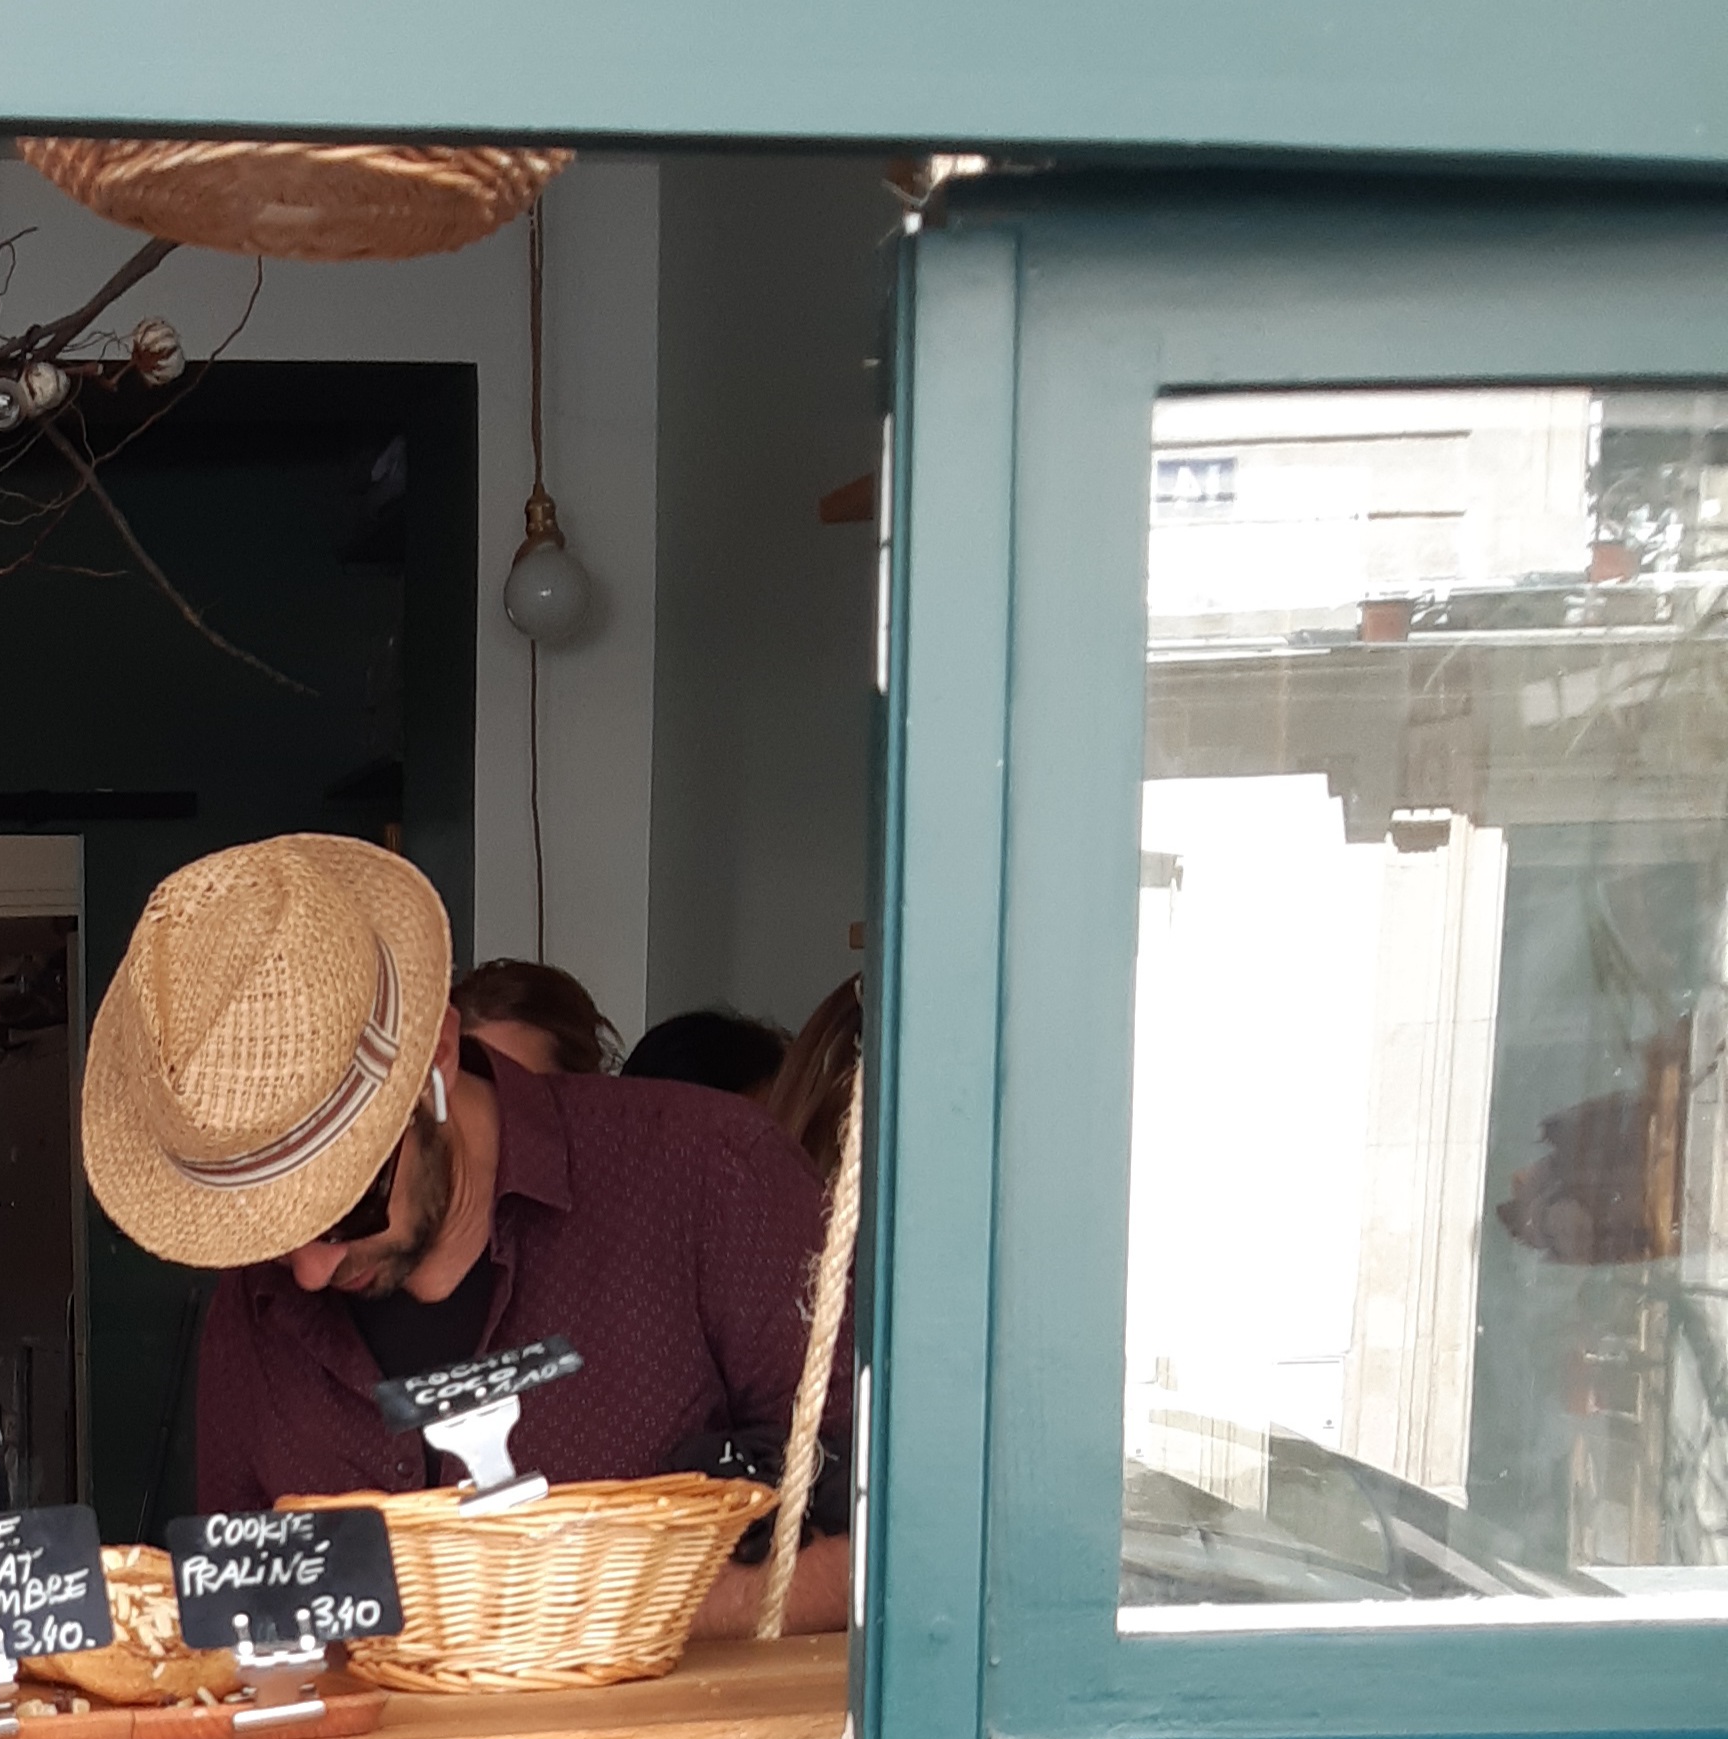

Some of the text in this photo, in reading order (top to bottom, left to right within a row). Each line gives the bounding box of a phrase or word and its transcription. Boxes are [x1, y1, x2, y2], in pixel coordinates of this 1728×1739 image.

[415, 1366, 518, 1405] COCO
[205, 1512, 315, 1546] COOKIE
[312, 1598, 381, 1633] 3,40
